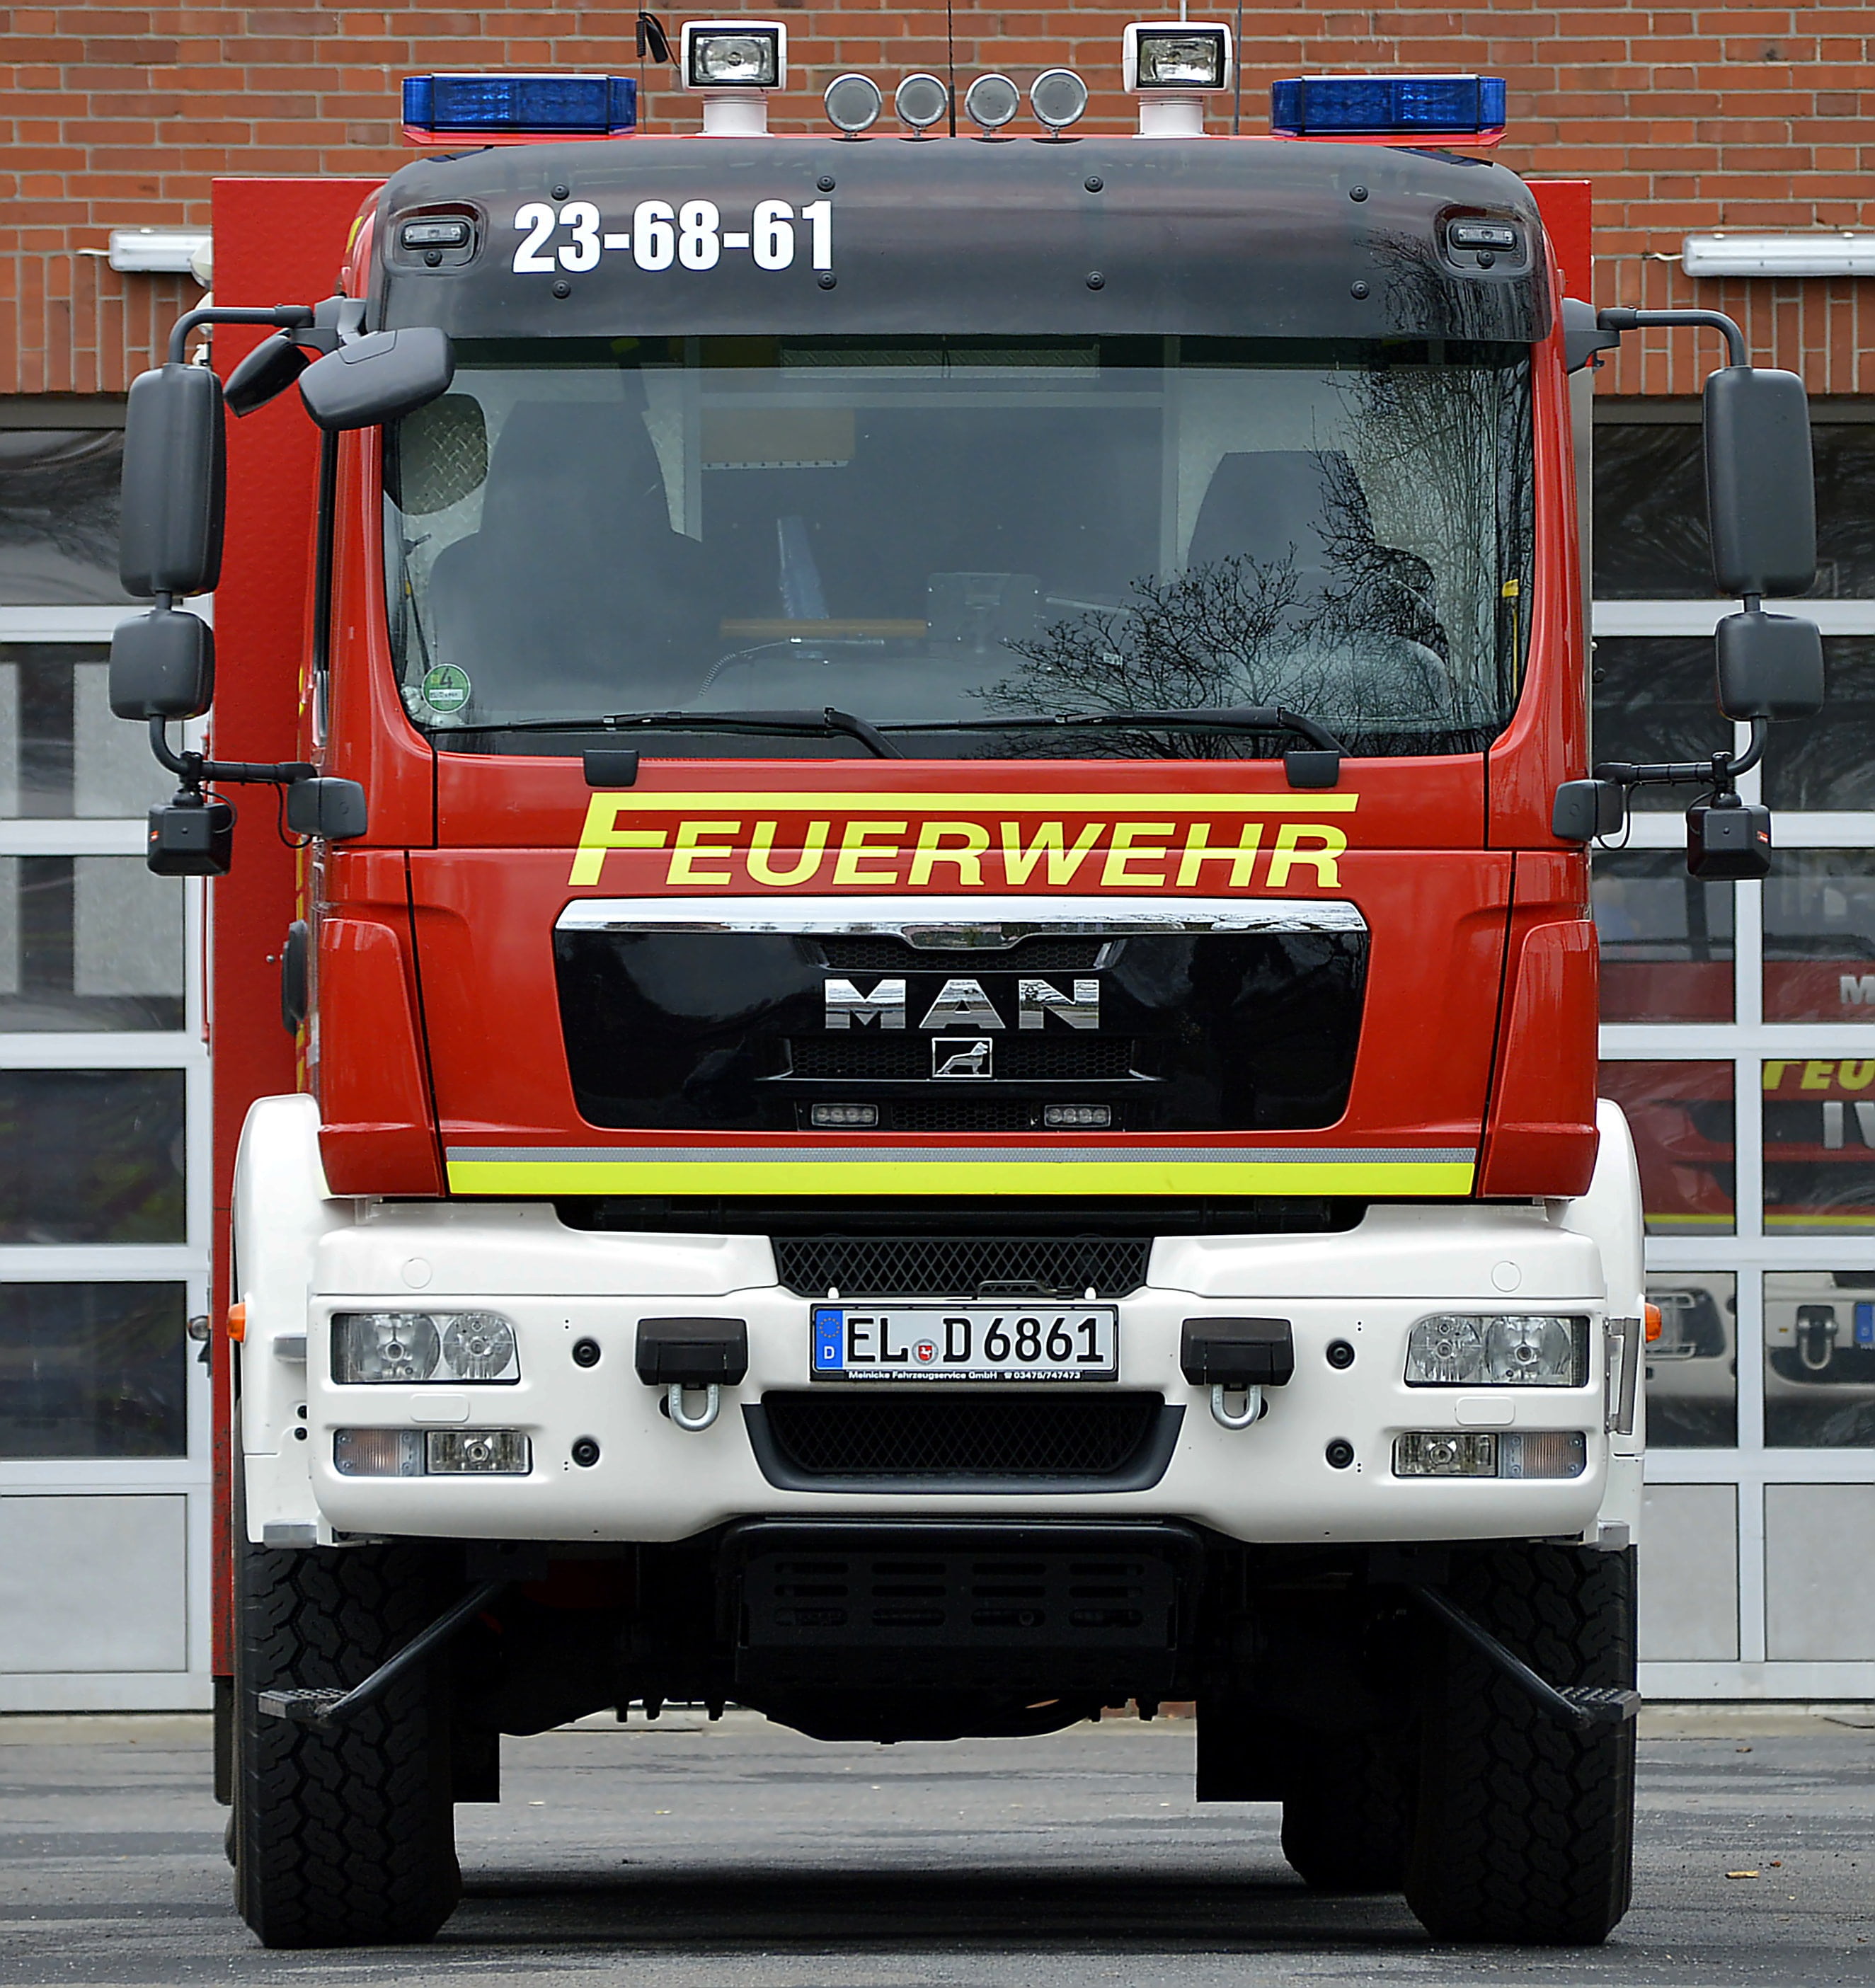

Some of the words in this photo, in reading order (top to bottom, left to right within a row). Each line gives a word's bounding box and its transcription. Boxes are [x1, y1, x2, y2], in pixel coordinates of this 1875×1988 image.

[512, 199, 833, 273] 23-68-61
[440, 667, 453, 689] 4
[568, 793, 1359, 887] FEUERWEHR
[825, 979, 1100, 1029] MAN
[824, 1346, 835, 1360] D
[847, 1318, 908, 1362] EL
[943, 1318, 971, 1362] D
[984, 1318, 1103, 1362] 6861
[848, 1371, 890, 1379] Meinicke
[892, 1371, 966, 1381] Fahrzeugservice
[968, 1371, 997, 1379] GmbH
